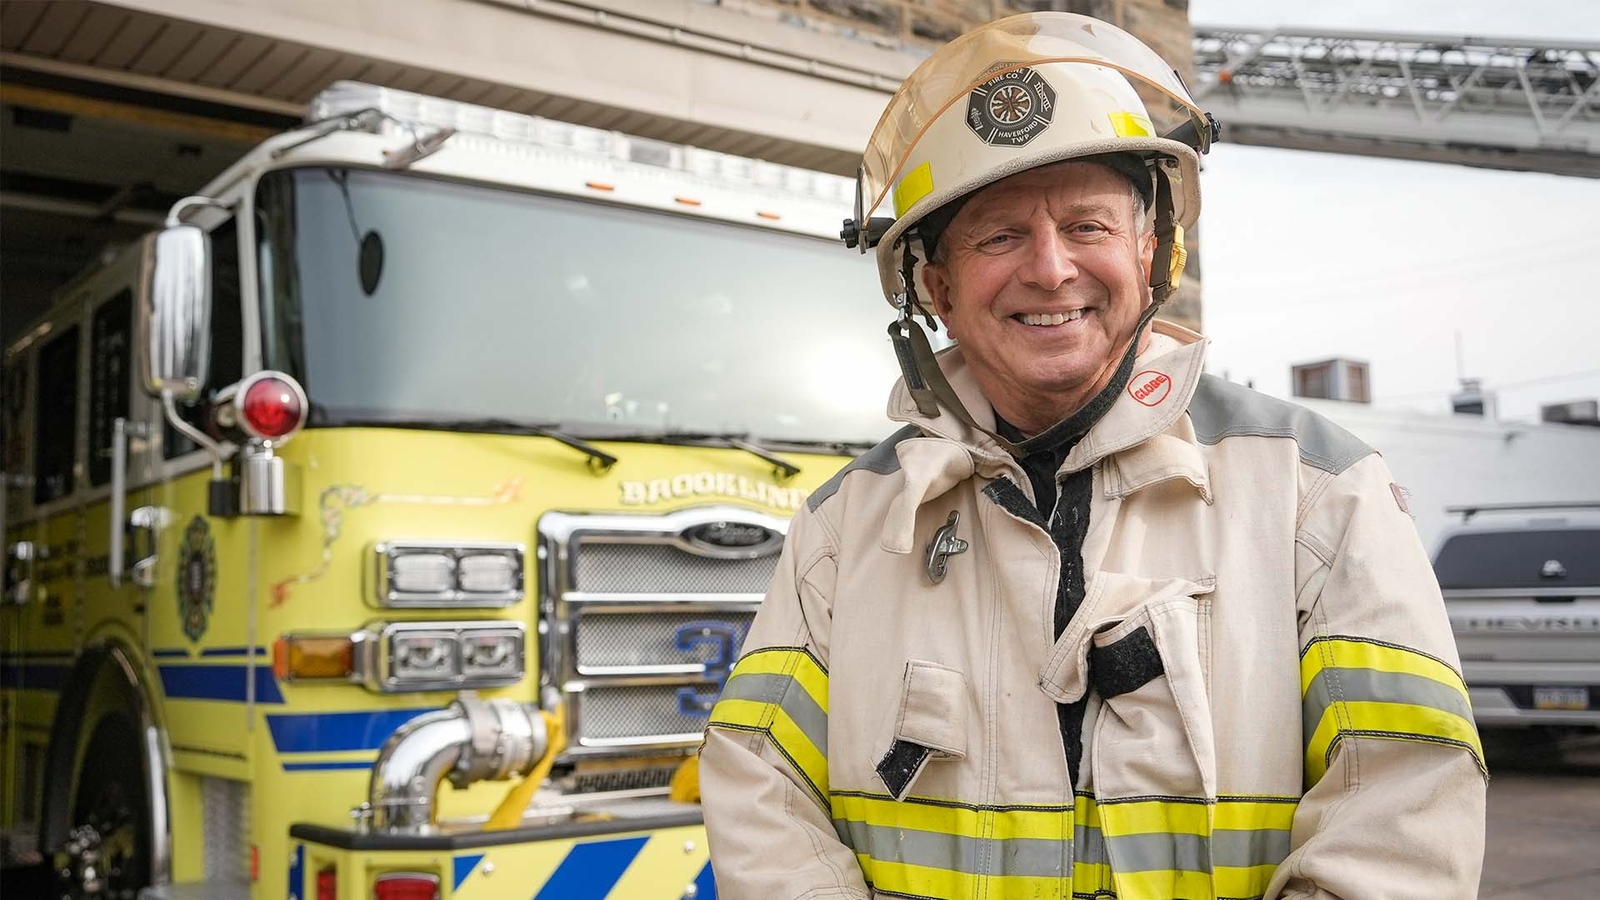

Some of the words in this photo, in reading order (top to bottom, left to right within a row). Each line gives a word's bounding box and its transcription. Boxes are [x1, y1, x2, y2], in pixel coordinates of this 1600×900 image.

[987, 75, 1005, 87] FIRE
[998, 120, 1038, 138] HAVERFORD
[1010, 133, 1033, 144] TWP.
[1134, 375, 1167, 400] GLOBE
